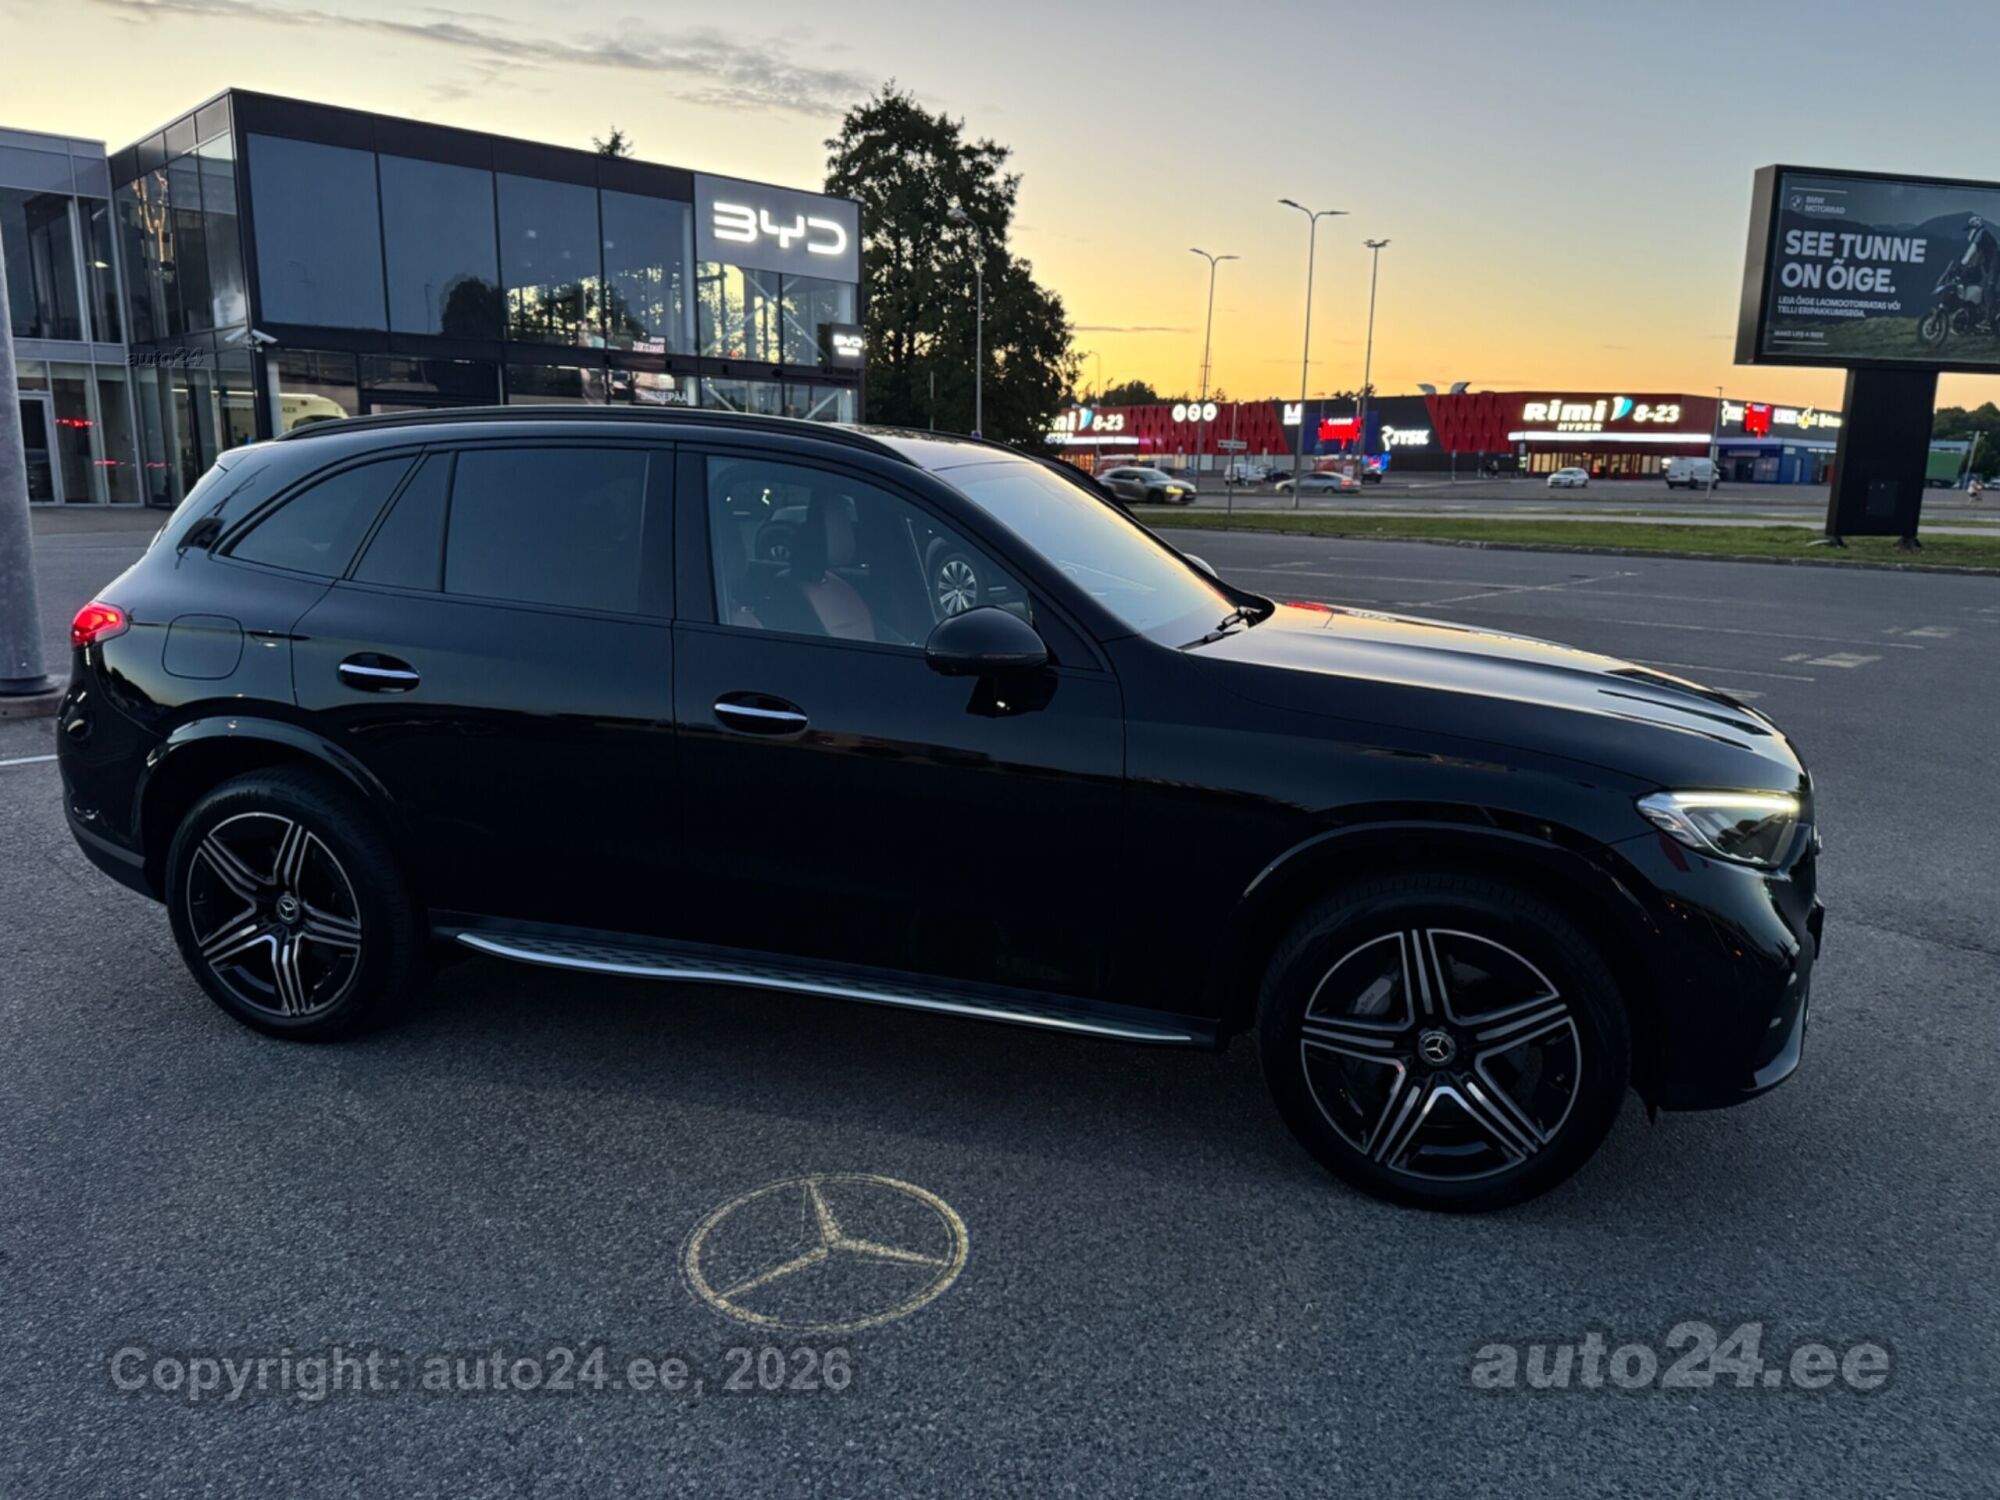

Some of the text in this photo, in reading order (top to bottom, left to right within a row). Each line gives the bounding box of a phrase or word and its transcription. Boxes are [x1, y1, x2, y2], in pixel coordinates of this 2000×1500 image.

[713, 201, 847, 255] BYD
[1784, 229, 1928, 263] SEE TUNNE
[1781, 258, 1896, 294] ON ÕIGE.
[1092, 413, 1124, 431] 8-23
[1522, 399, 1680, 422] Rimi 8-23
[1557, 422, 1602, 431] HYPER
